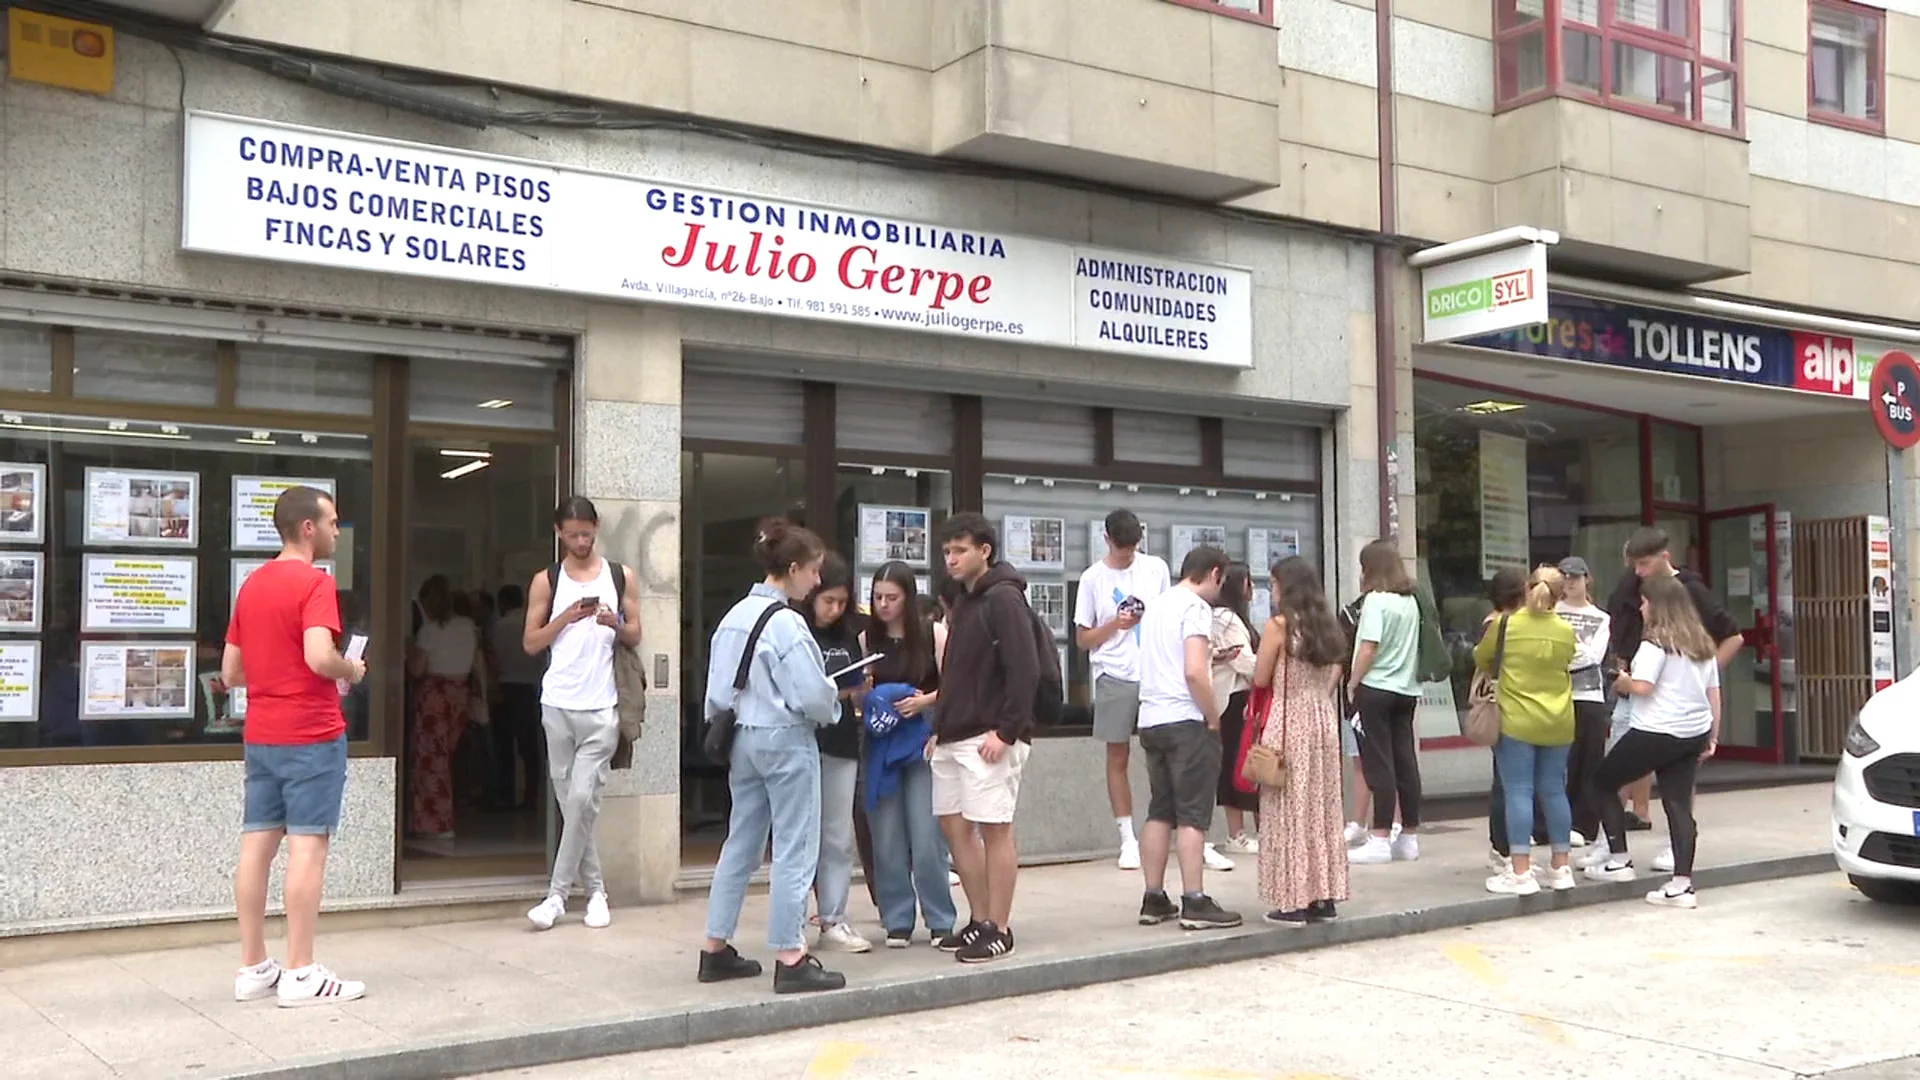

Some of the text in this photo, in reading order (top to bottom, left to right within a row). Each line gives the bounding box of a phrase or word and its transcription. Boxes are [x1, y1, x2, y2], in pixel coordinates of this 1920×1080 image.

[239, 136, 552, 203] COMPRA-VENTA PISOS
[247, 177, 544, 238] BAJOS COMERCIALES
[646, 188, 1007, 259] GESTION INMOBILIARIA
[265, 218, 527, 271] FINCAS Y SOLARES
[661, 222, 993, 309] Julio Gerpe
[1076, 257, 1228, 296] ADMINISTRACION
[1431, 278, 1525, 314] BRICO SYL
[621, 278, 652, 292] Avda.
[806, 300, 825, 312] 981
[829, 302, 848, 315] 591
[851, 305, 871, 317] 585
[881, 308, 1024, 335] www.juliogerpe.es
[1089, 289, 1217, 324] COMUNIDADES
[1098, 320, 1209, 351] ALQUILERES
[1628, 319, 1763, 373] TOLLENS
[1803, 336, 1853, 392] alp
[1897, 381, 1906, 397] P
[1889, 404, 1913, 421] BUS
